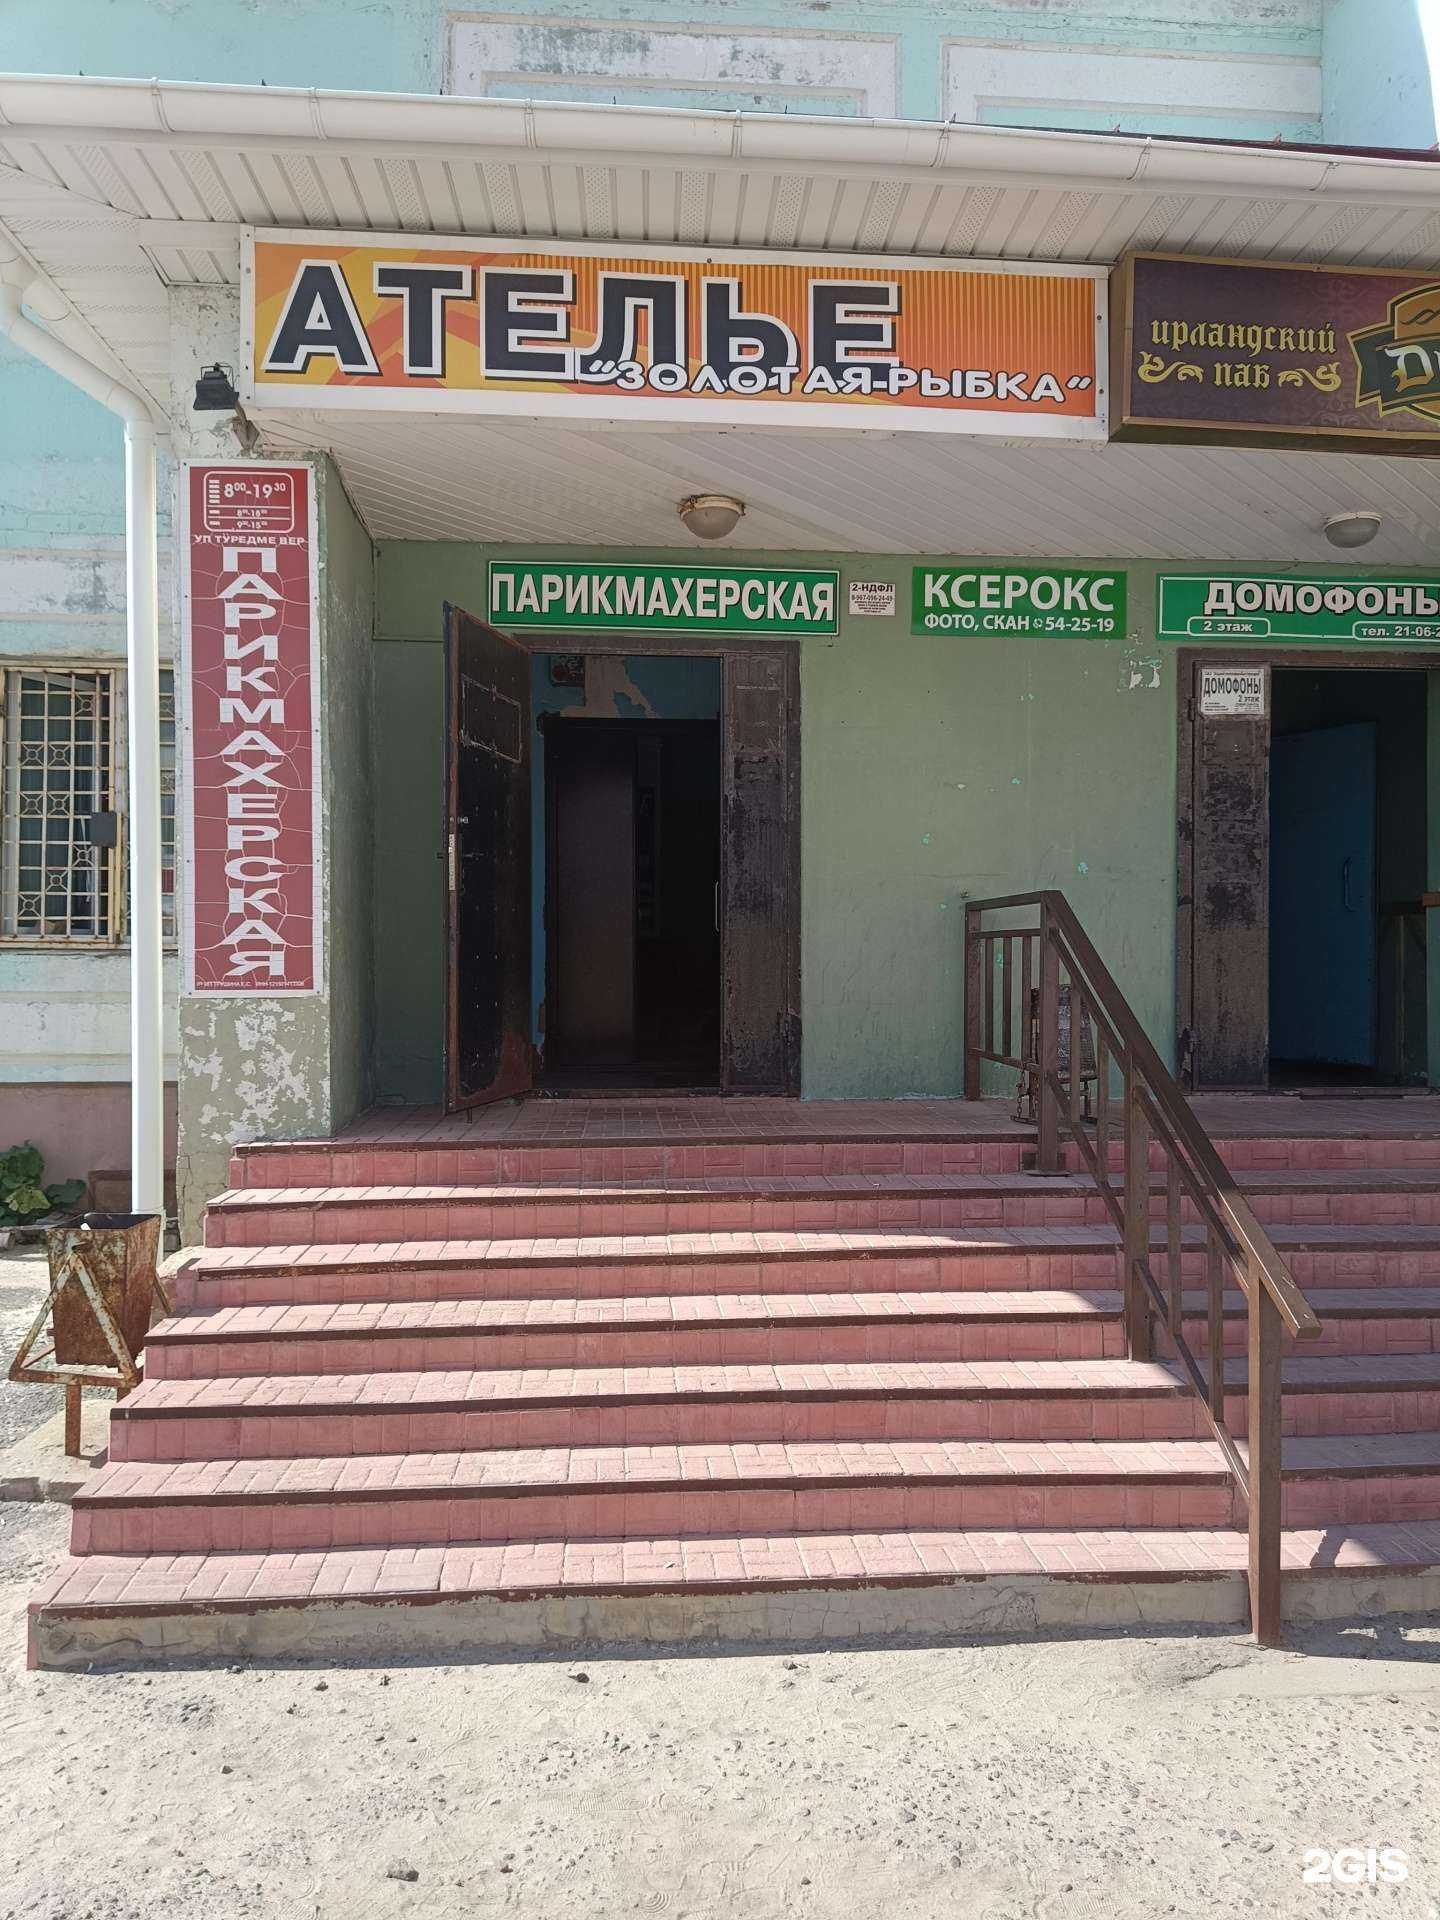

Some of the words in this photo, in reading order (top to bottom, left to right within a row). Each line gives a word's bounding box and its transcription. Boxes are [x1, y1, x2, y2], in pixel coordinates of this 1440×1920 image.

[260, 258, 902, 388] АТЕЛЬЕ
[1214, 362, 1270, 388] паб
[492, 573, 834, 621] ПАРИКМАХЕРСКАЯ
[852, 584, 893, 593] 2-НДФЛ
[924, 574, 1114, 611] КСЕРОКС
[924, 613, 979, 631] ФОТО,
[983, 614, 1030, 630] СКАН
[1045, 616, 1114, 632] 54-25-19
[1203, 621, 1212, 631] 2
[1217, 623, 1253, 632] этаж
[1361, 626, 1390, 637] тел.
[1203, 677, 1262, 697] ДОМОФОНЫ
[218, 546, 285, 976] ПАРИКМАХЕРСКАЯ
